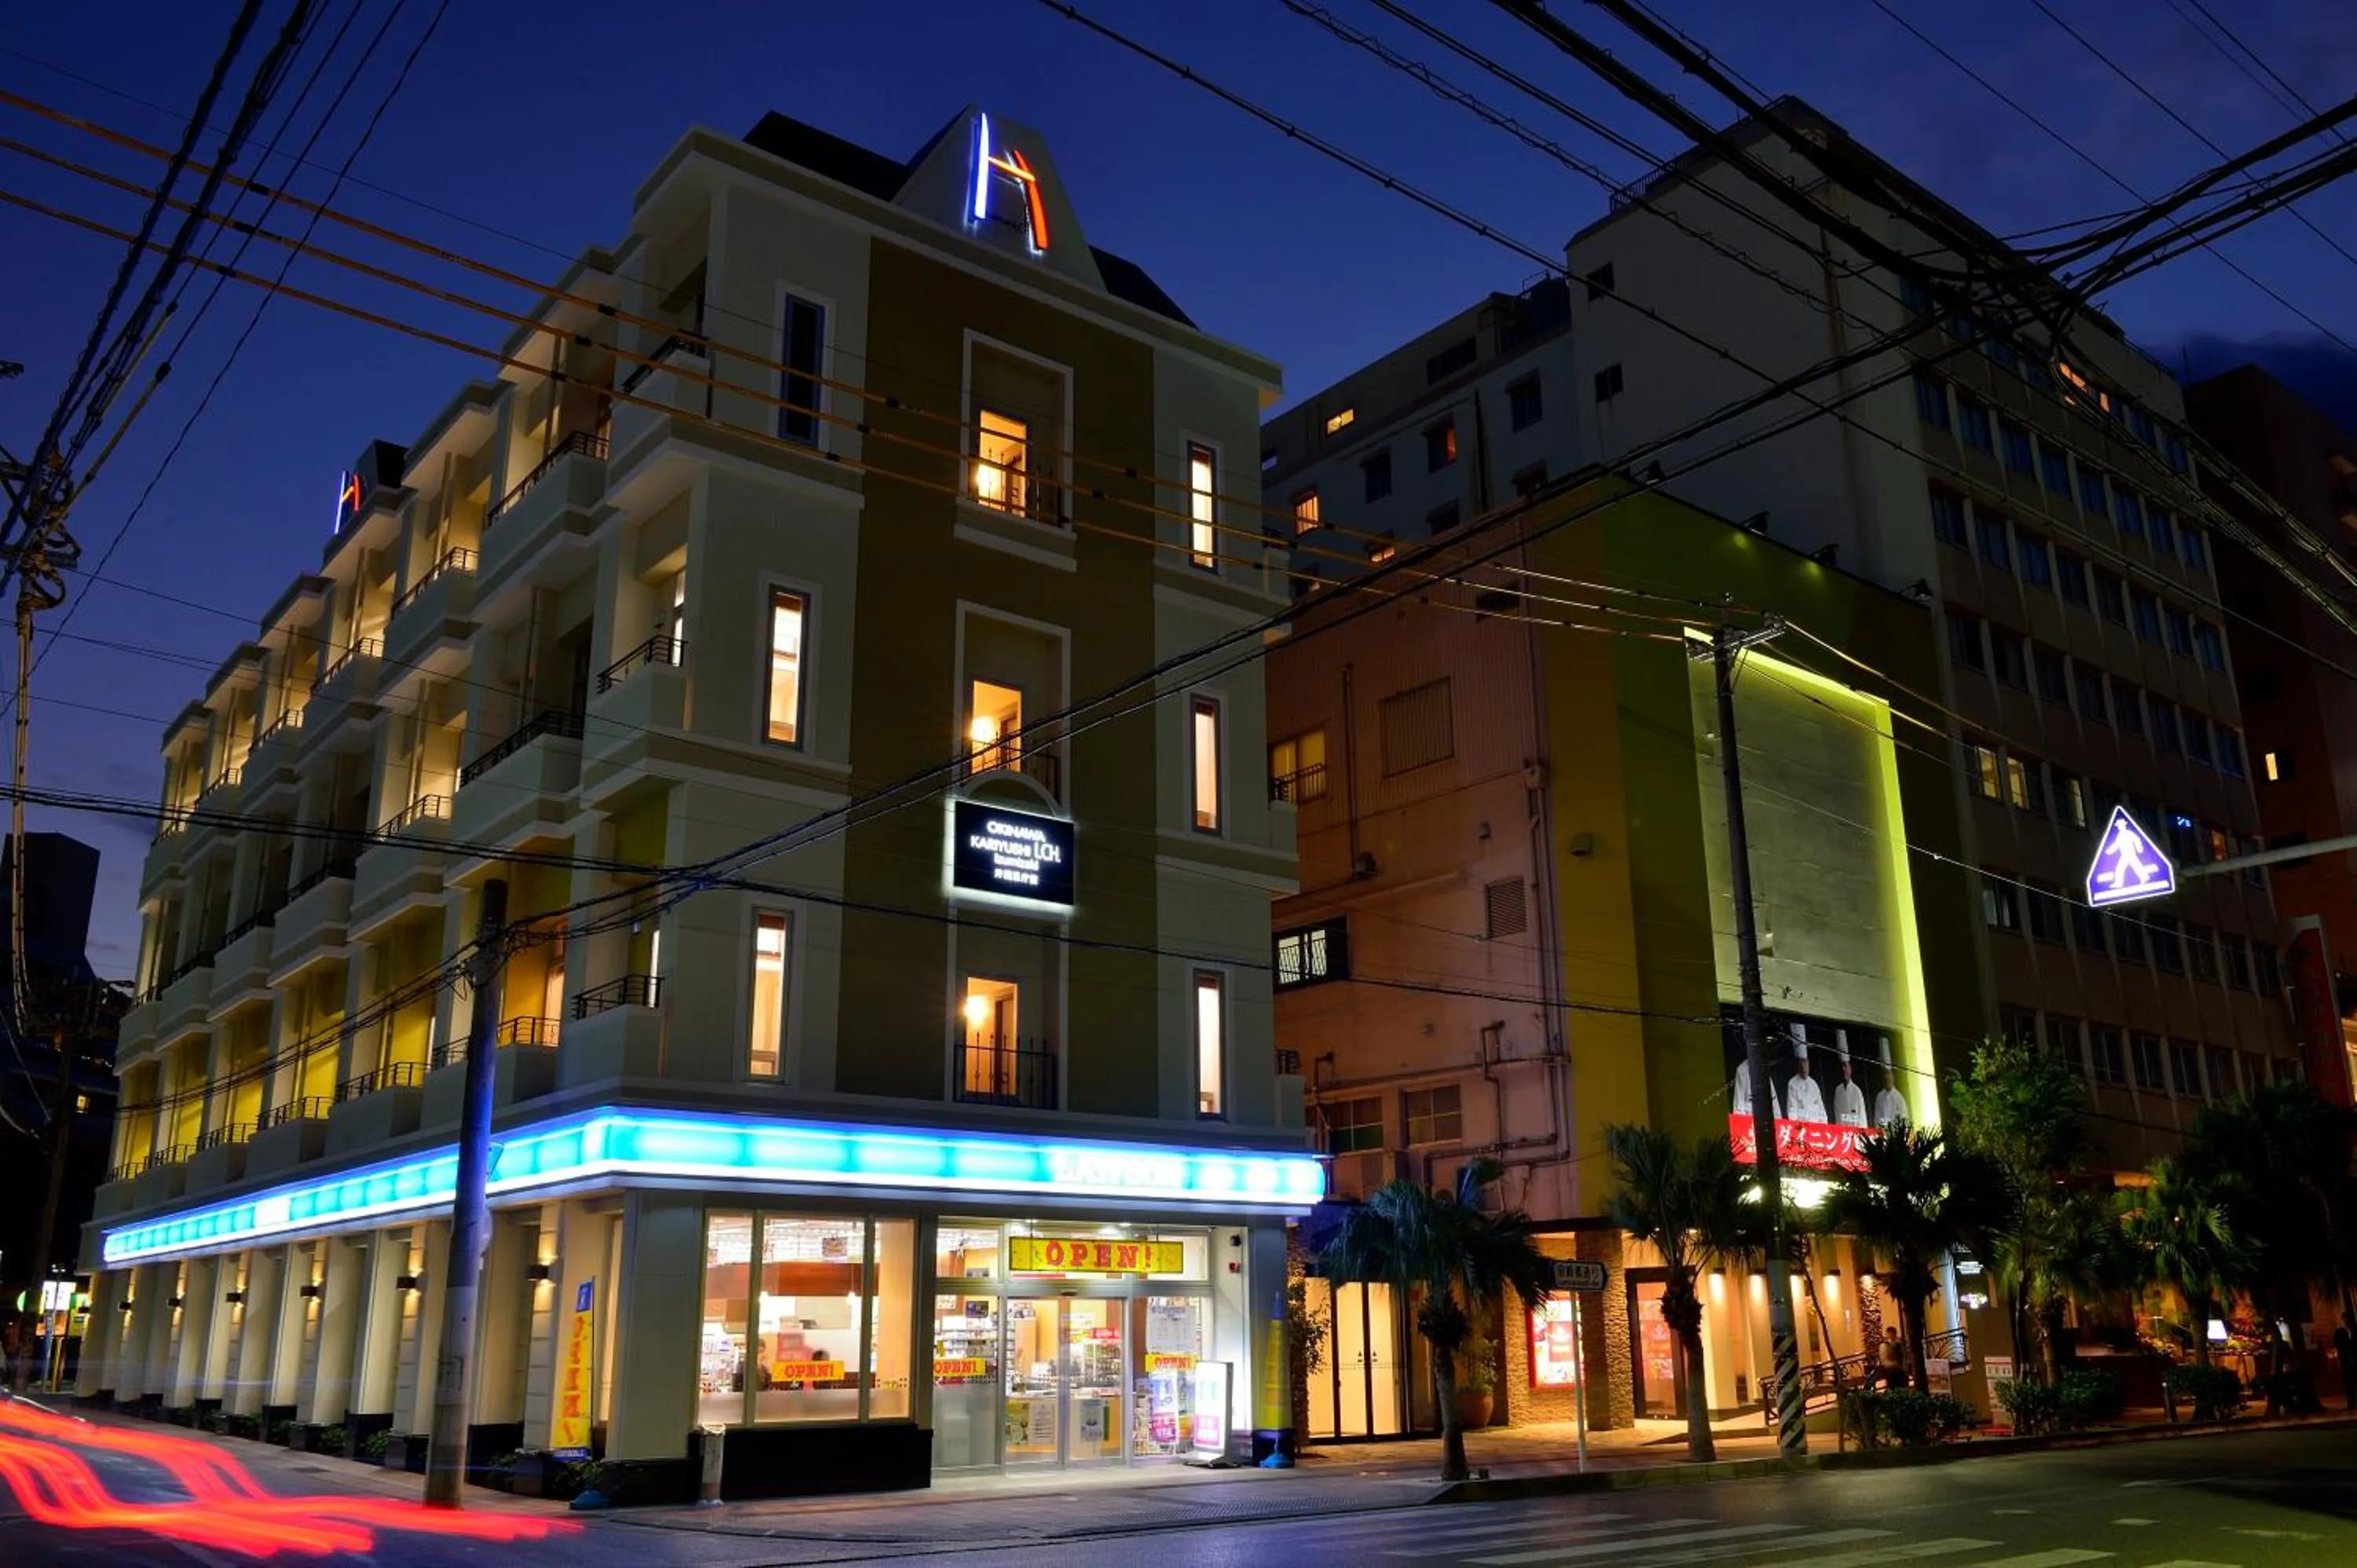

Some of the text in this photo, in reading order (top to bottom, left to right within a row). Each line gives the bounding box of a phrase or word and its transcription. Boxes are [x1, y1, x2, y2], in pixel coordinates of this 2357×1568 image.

[987, 821, 1046, 842] OKINAWA
[1045, 1240, 1152, 1269] OPEN!
[784, 1361, 836, 1379] OPEN!
[934, 1359, 978, 1376] OPEN!
